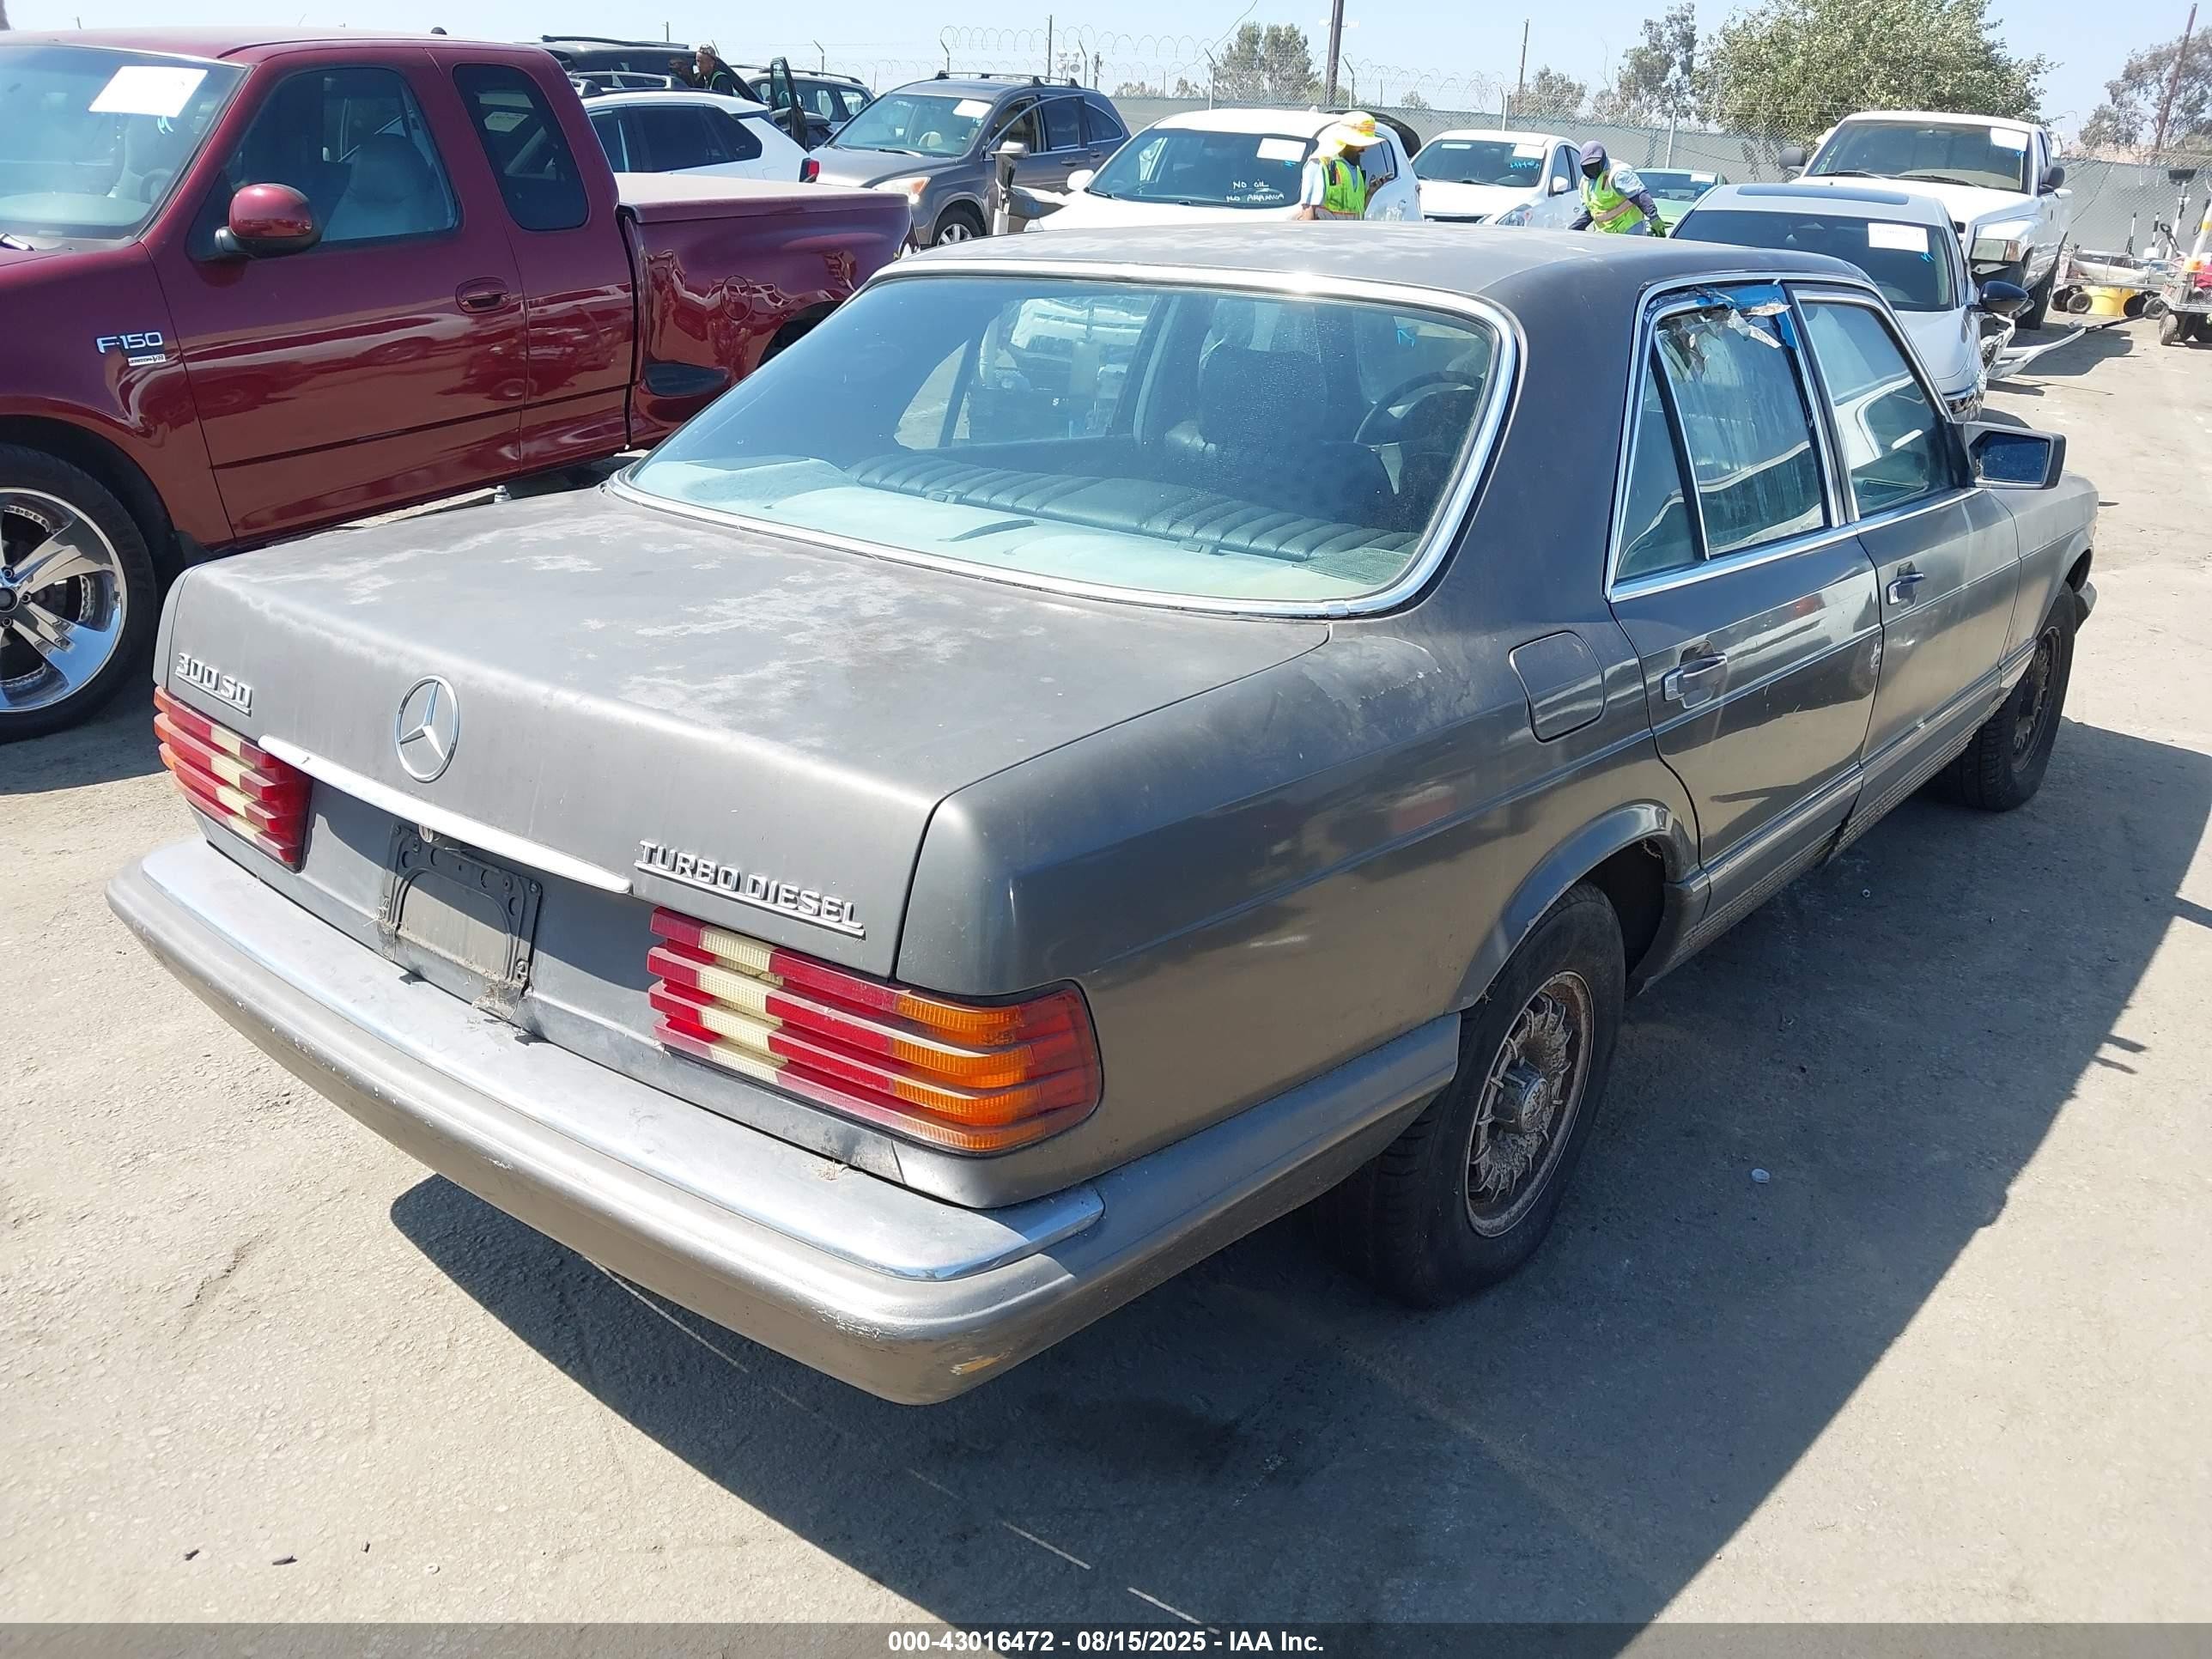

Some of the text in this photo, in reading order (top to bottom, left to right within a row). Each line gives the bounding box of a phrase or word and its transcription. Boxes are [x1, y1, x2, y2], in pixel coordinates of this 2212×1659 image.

[96, 331, 163, 353] F-150
[638, 839, 865, 930] TURBO DIESEL
